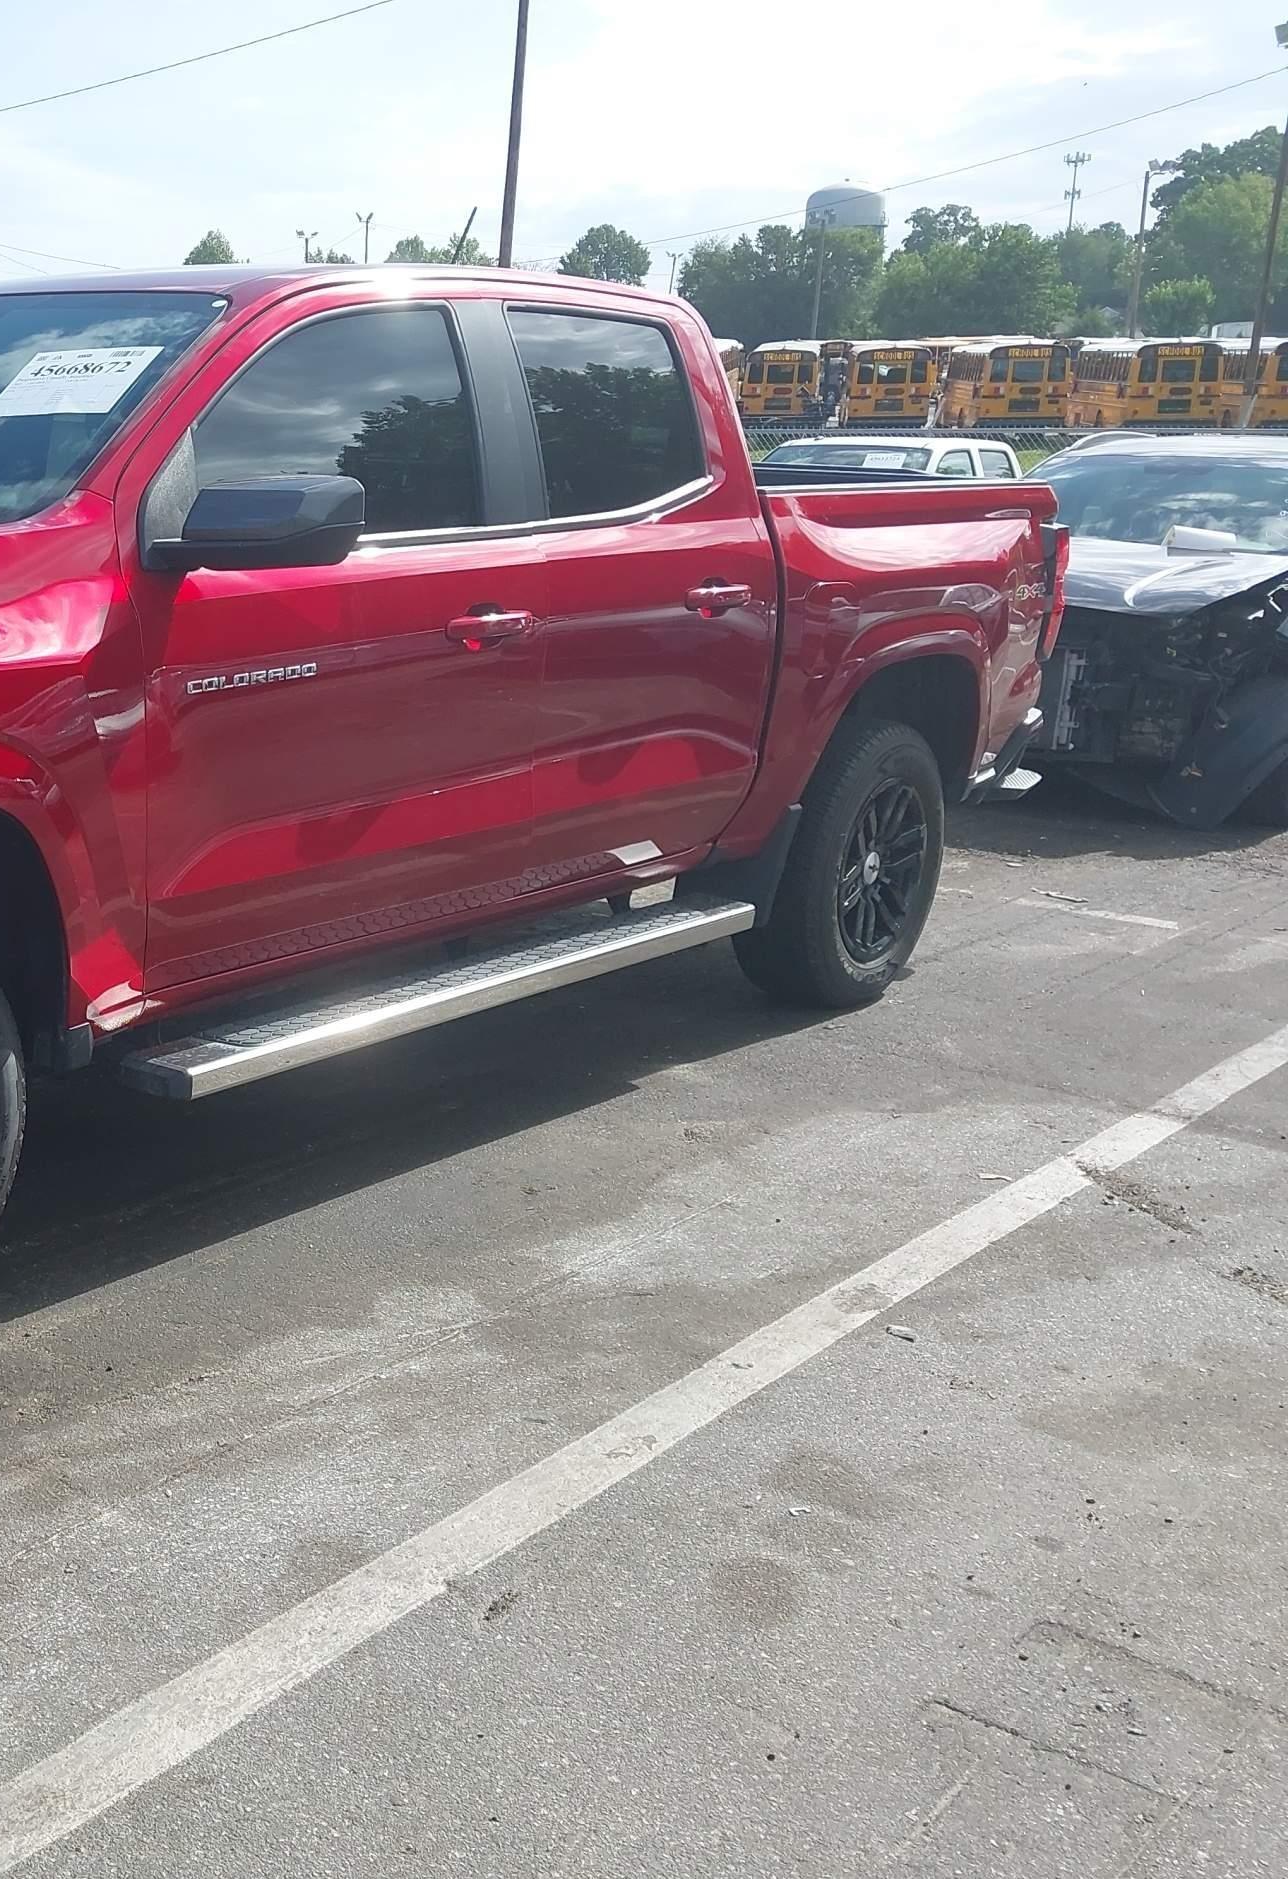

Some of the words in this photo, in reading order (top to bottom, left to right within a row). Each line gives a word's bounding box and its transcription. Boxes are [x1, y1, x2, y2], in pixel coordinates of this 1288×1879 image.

[874, 352, 899, 360] SCHOOL
[1009, 348, 1036, 358] SCHOOL
[1159, 347, 1188, 356] SCHOOL
[764, 352, 787, 361] SCHOOL
[30, 361, 132, 377] 45668672
[186, 662, 318, 695] COLORADO
